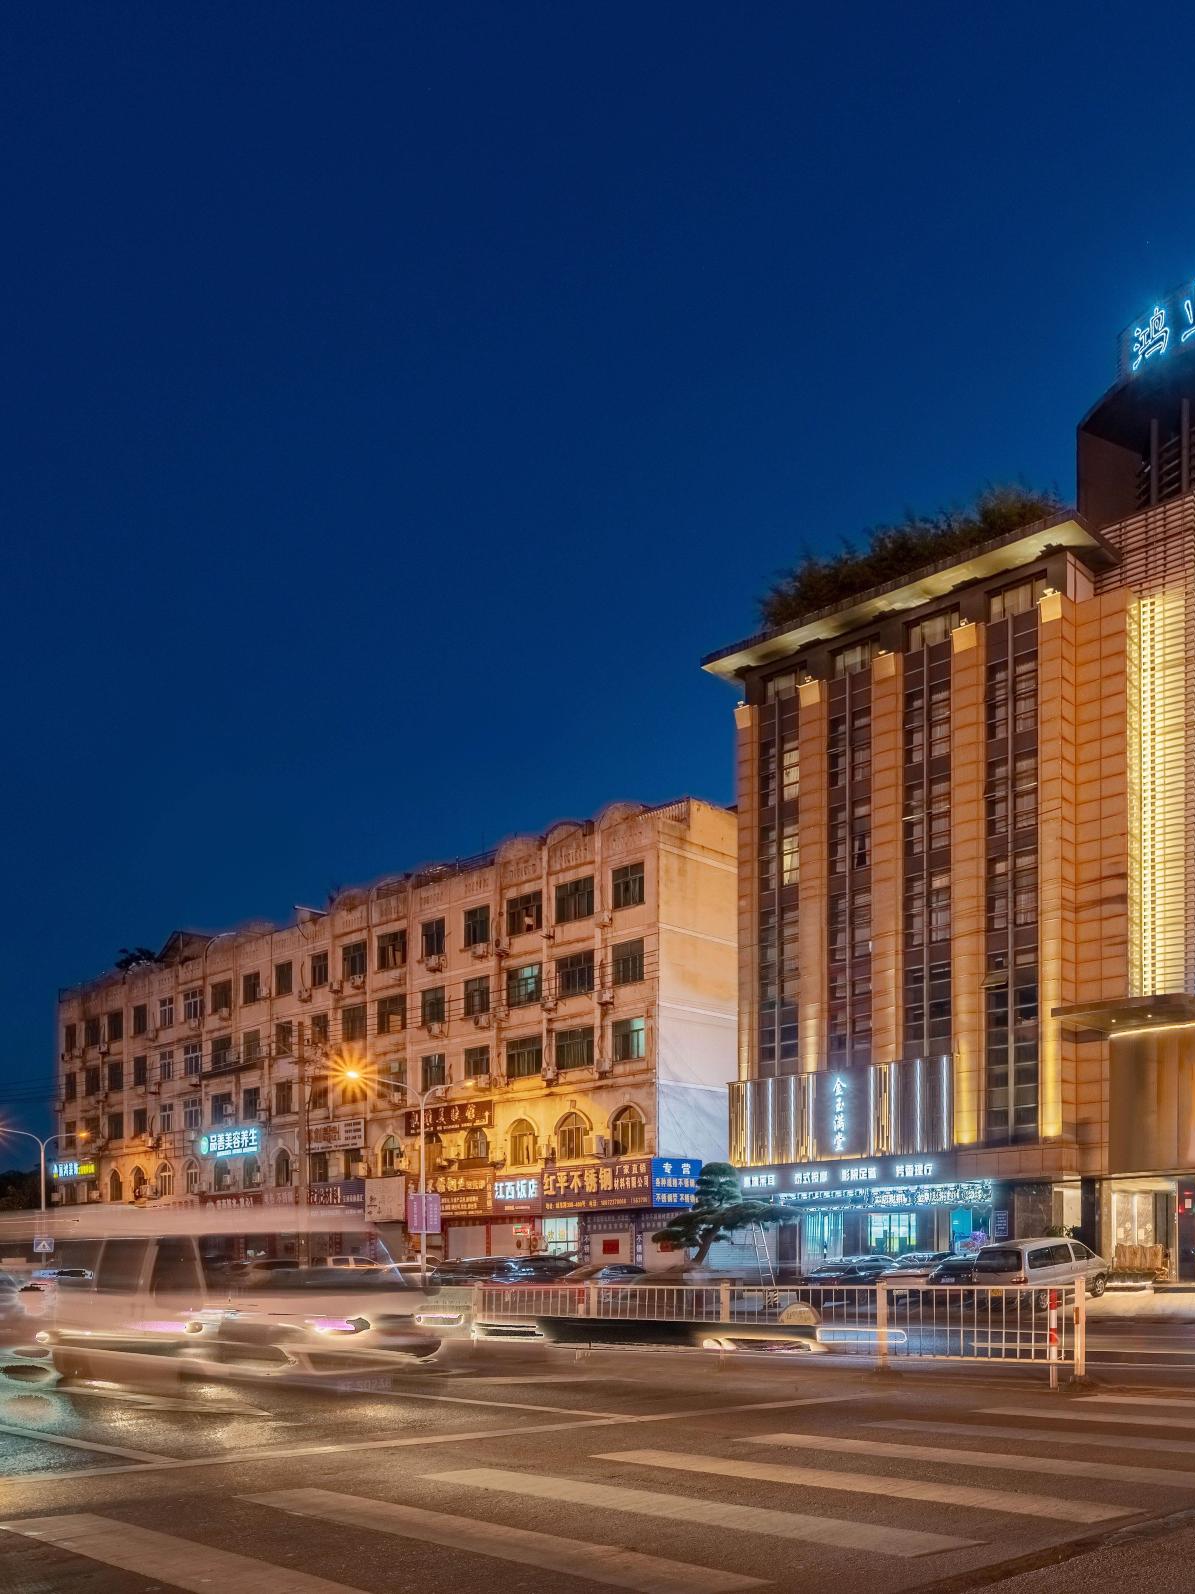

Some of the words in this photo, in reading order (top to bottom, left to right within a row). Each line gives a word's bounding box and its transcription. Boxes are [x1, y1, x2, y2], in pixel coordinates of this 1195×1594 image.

[832, 1077, 847, 1152] 金玉满堂
[209, 1128, 258, 1152] 品善美容养生
[494, 1178, 538, 1200] 江西饭店
[543, 1168, 614, 1196] 红平不锈钢
